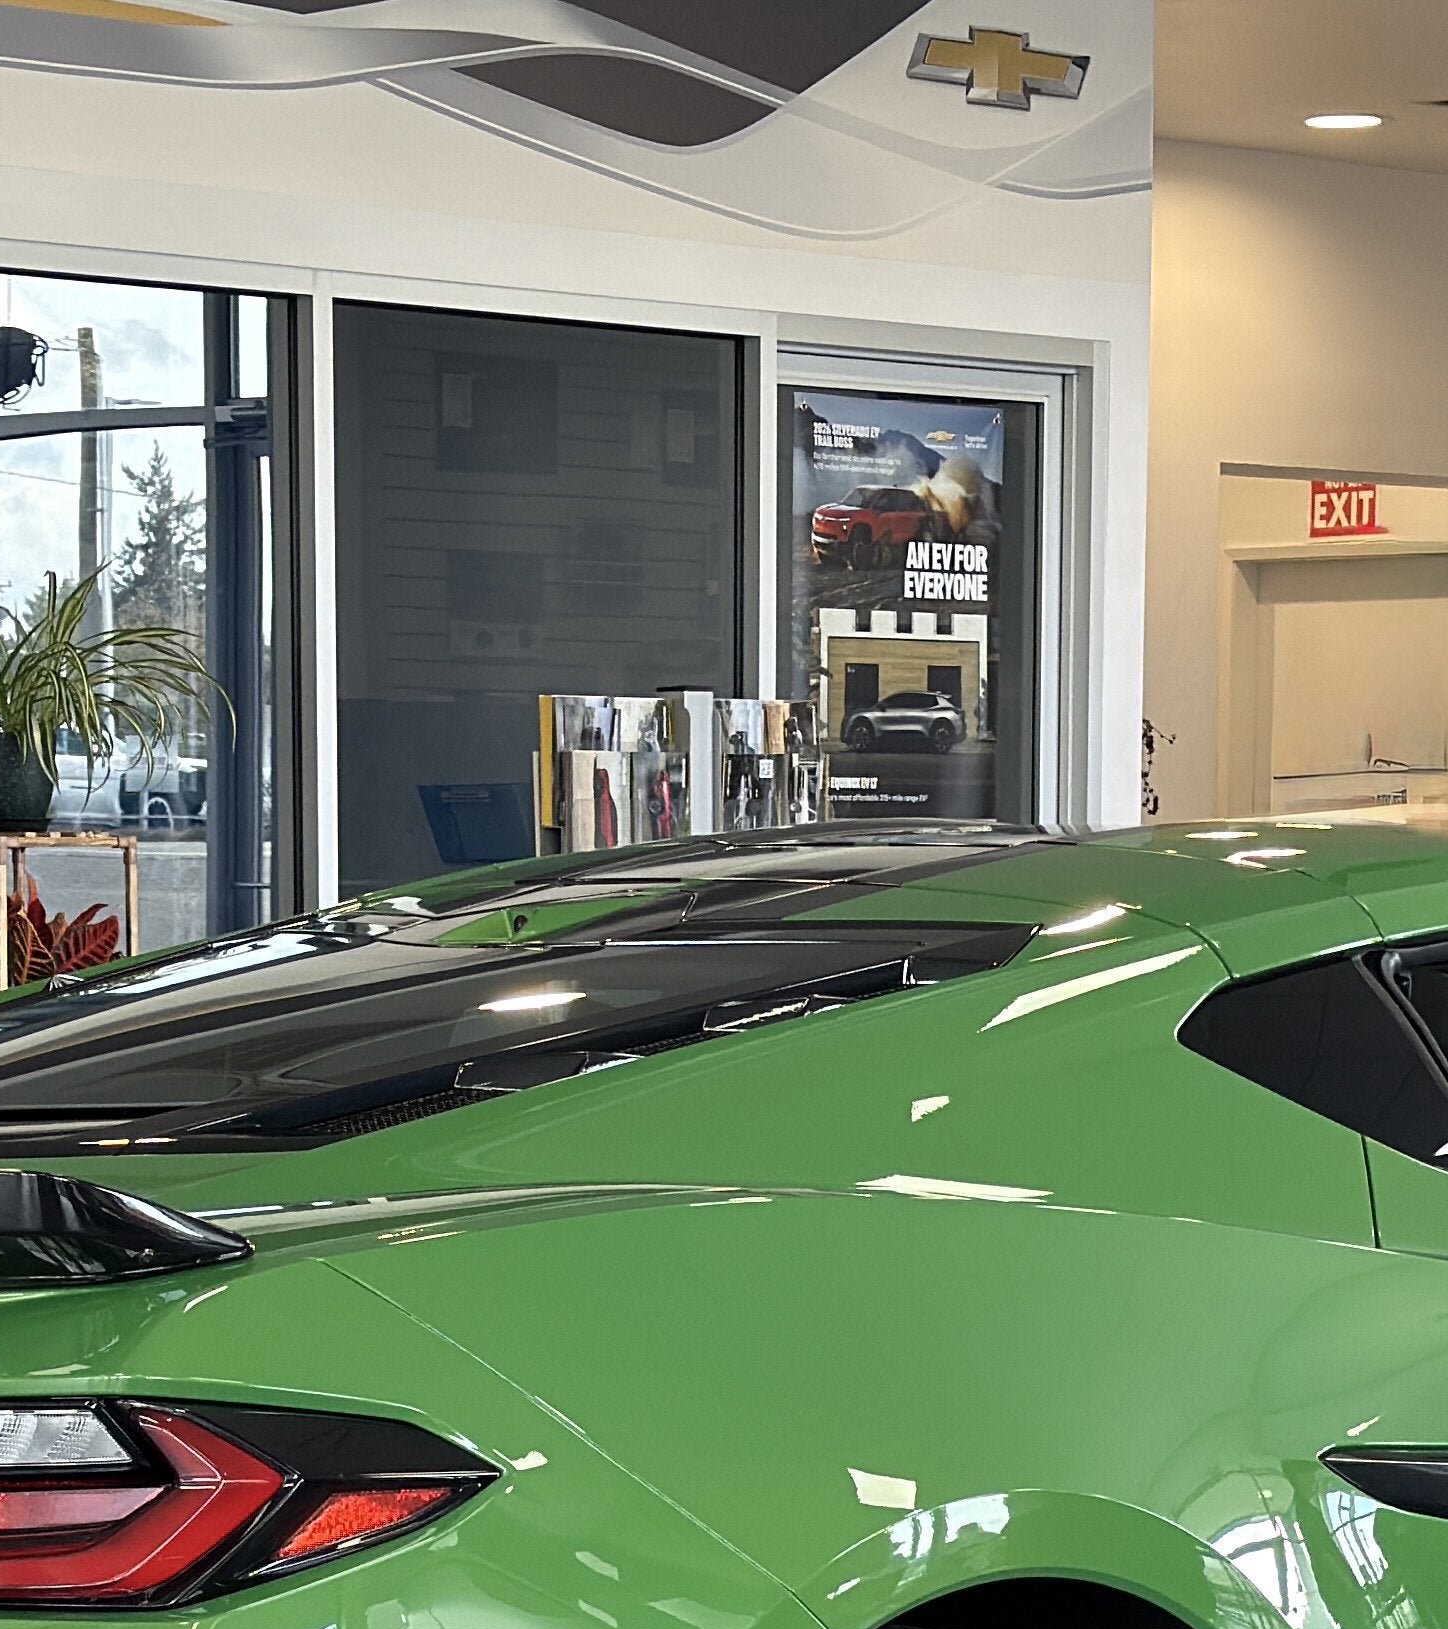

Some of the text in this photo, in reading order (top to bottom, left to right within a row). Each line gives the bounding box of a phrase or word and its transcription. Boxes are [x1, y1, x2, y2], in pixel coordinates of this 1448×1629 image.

[1314, 490, 1374, 528] EXIT
[906, 541, 988, 572] AN EV FOR
[904, 570, 988, 601] EVERYONE
